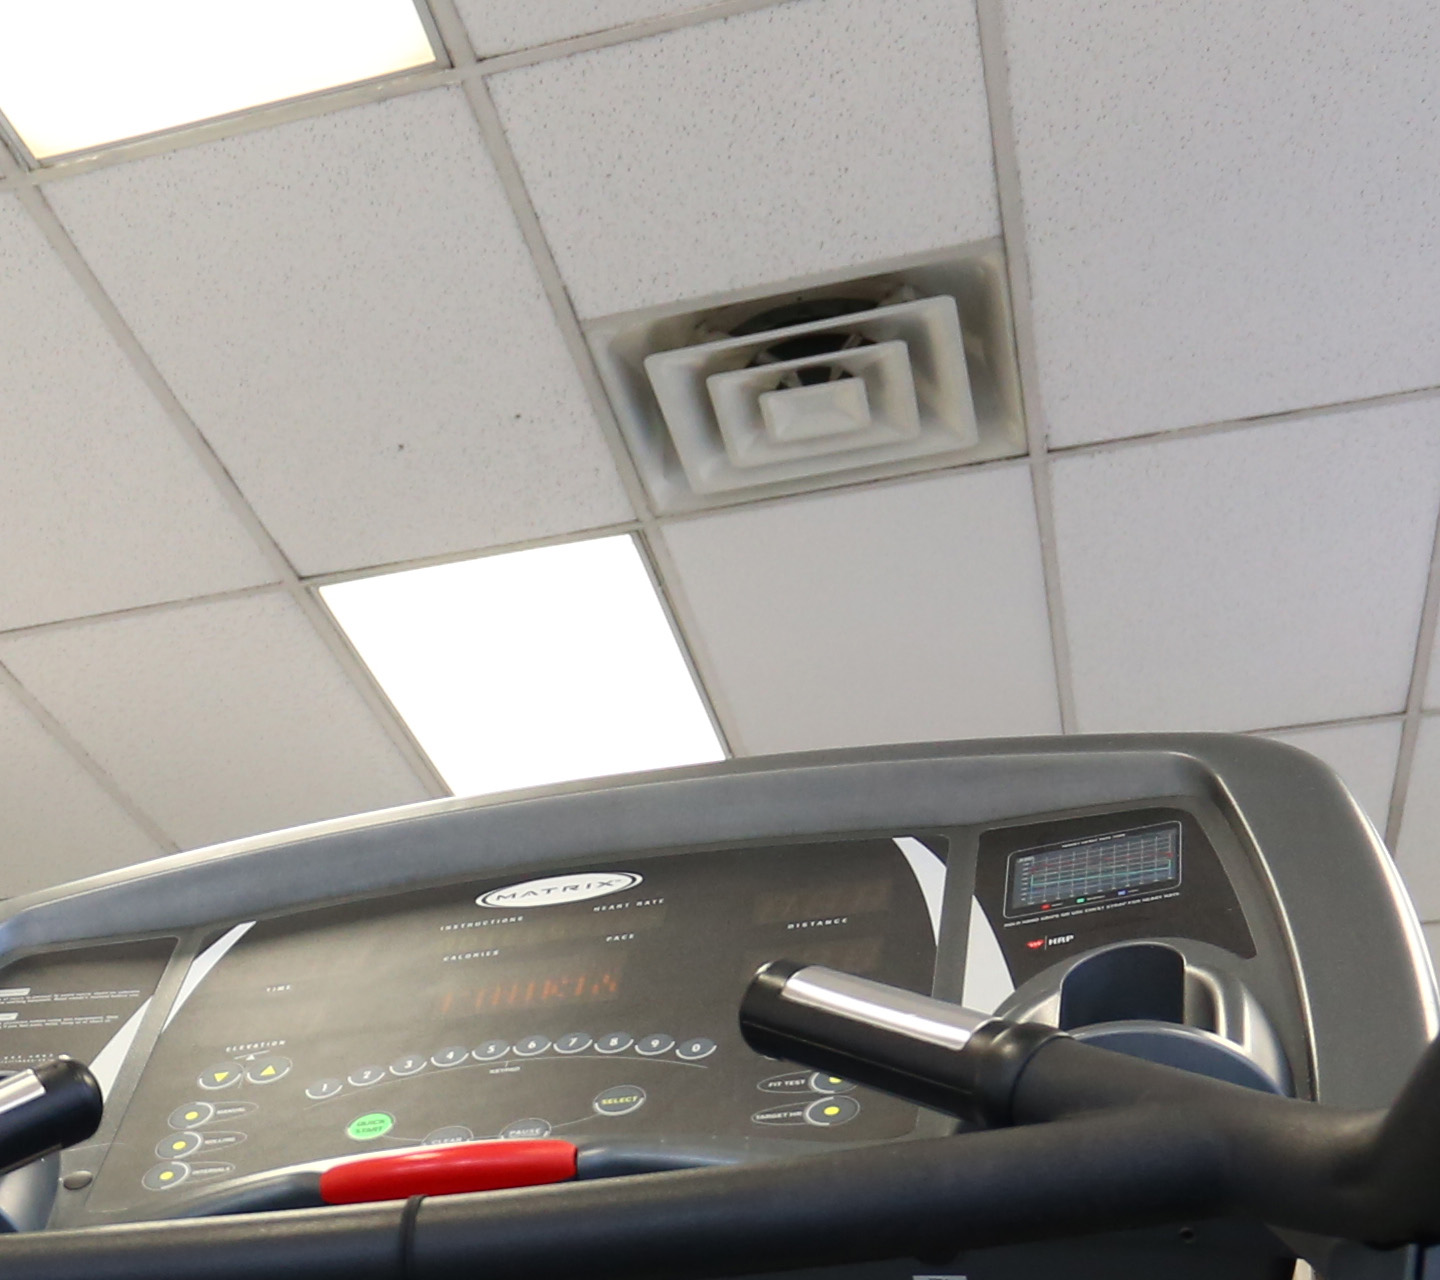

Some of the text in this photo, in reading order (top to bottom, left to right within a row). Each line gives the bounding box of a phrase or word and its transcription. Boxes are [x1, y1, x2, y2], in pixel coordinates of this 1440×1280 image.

[495, 879, 615, 901] MATRIX
[593, 898, 665, 912] HEART RATE
[440, 915, 524, 931] INSTRUCTIONS
[787, 917, 848, 929] DISTANCE
[605, 933, 634, 942] PACE
[1048, 934, 1074, 946] HRP
[443, 949, 500, 961] CALORIES
[266, 984, 292, 992] TIME
[225, 1039, 286, 1052] ELEVATION
[322, 1037, 701, 1092] 1 2 3 4 5 6 7 8 9 0
[601, 1096, 638, 1105] SELECT
[509, 1128, 541, 1137] PAUSE
